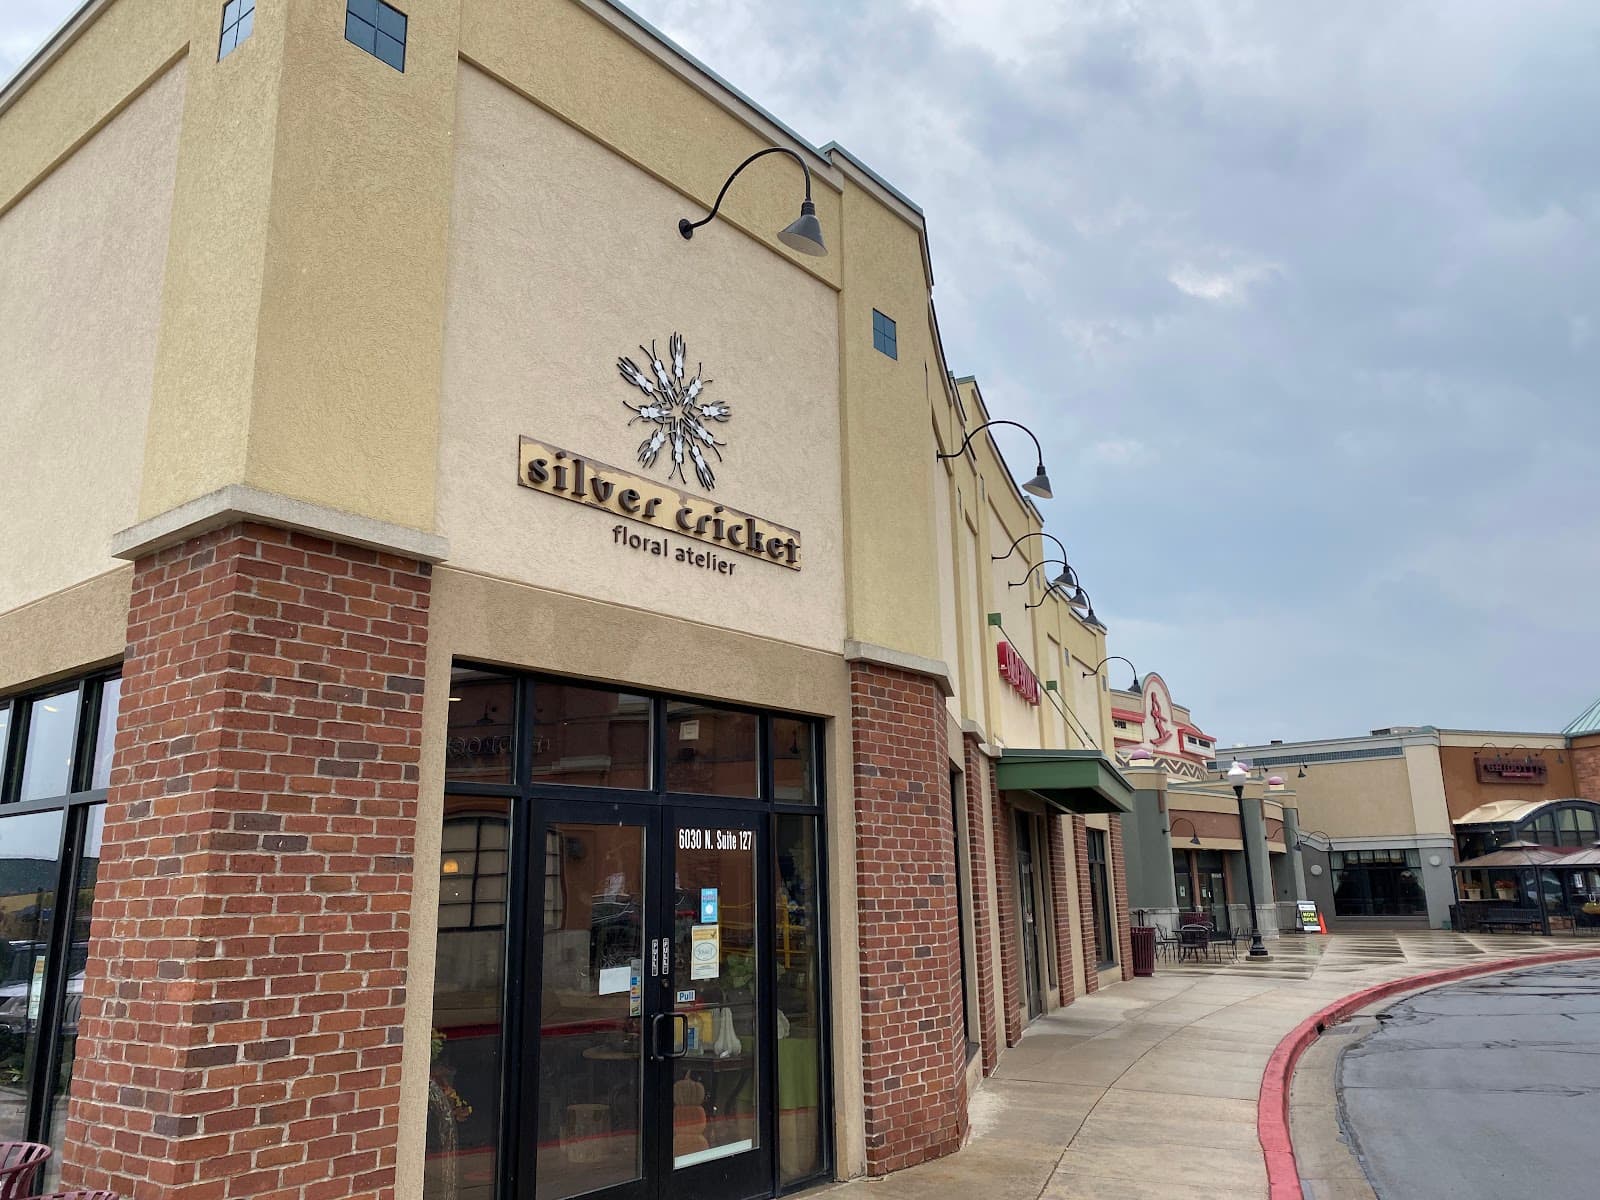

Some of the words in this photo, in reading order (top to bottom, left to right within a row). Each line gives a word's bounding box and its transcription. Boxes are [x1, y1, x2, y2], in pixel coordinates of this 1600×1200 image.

[527, 450, 663, 519] silver
[675, 505, 800, 564] cricket
[612, 524, 668, 557] floral
[675, 546, 737, 576] atelier
[679, 828, 702, 850] 6030
[704, 829, 714, 850] N.
[716, 829, 737, 850] Suite
[739, 830, 752, 851] 127
[680, 991, 694, 1001] Pull
